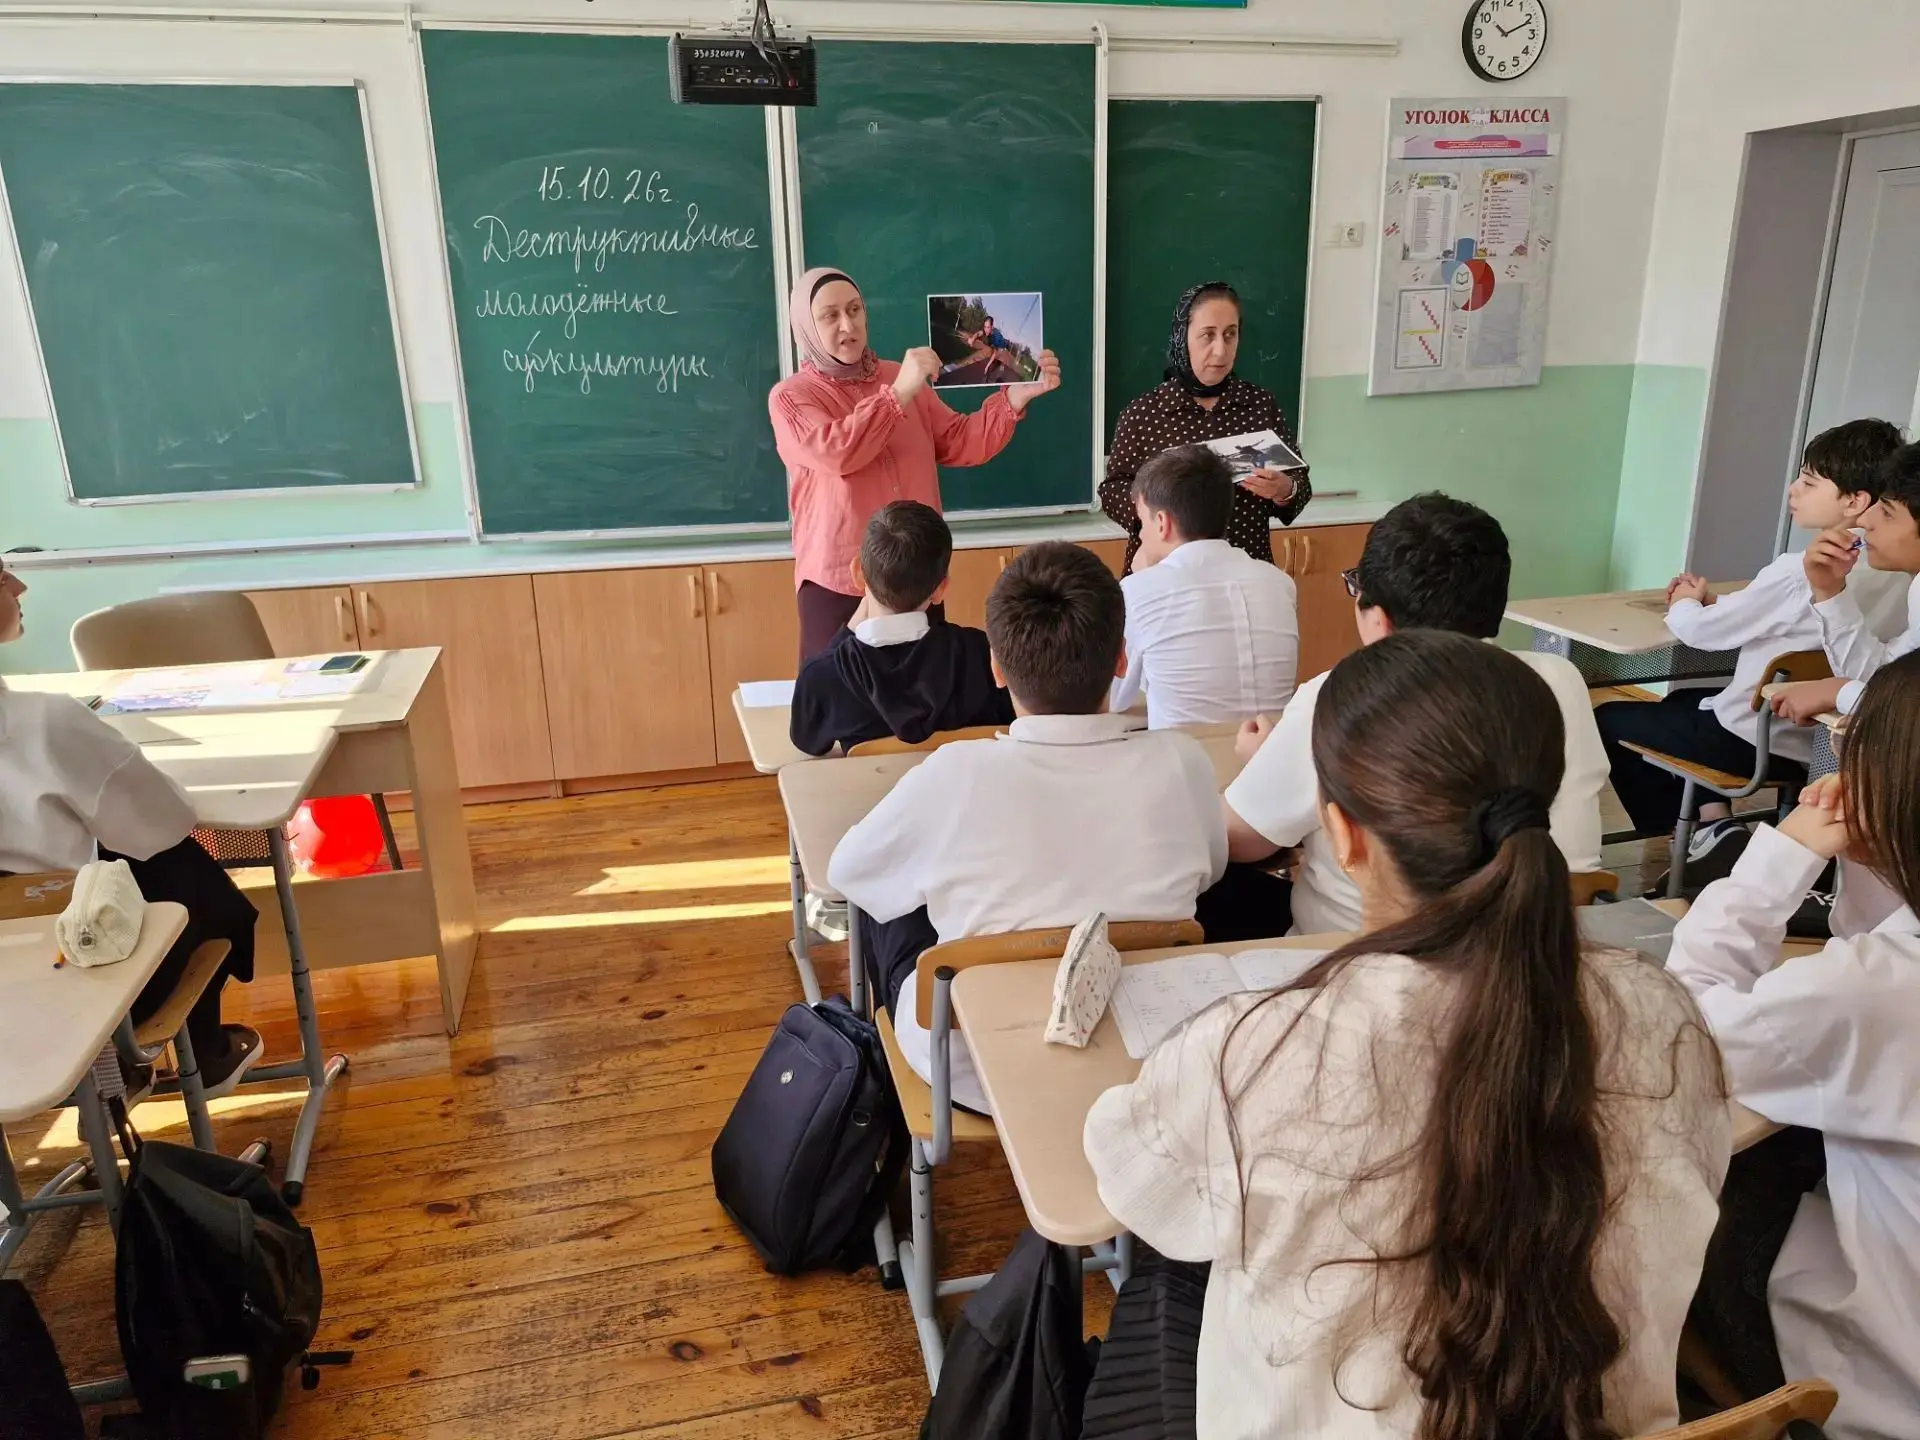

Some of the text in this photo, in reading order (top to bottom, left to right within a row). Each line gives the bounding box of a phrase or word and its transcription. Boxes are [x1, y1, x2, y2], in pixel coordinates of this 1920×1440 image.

[1490, 0, 1500, 12] 11
[1480, 12, 1491, 23] 10
[1525, 13, 1532, 24] 2
[1474, 28, 1482, 39] 9
[1528, 29, 1535, 40] 3
[1477, 44, 1485, 55] 8
[1521, 45, 1529, 56] 4
[1487, 56, 1494, 67] 7
[1498, 61, 1506, 72] 6
[1512, 56, 1519, 67] 5
[1405, 109, 1470, 124] УГОЛОК
[1489, 108, 1550, 123] КЛАССА
[473, 202, 760, 273] Деструктивные
